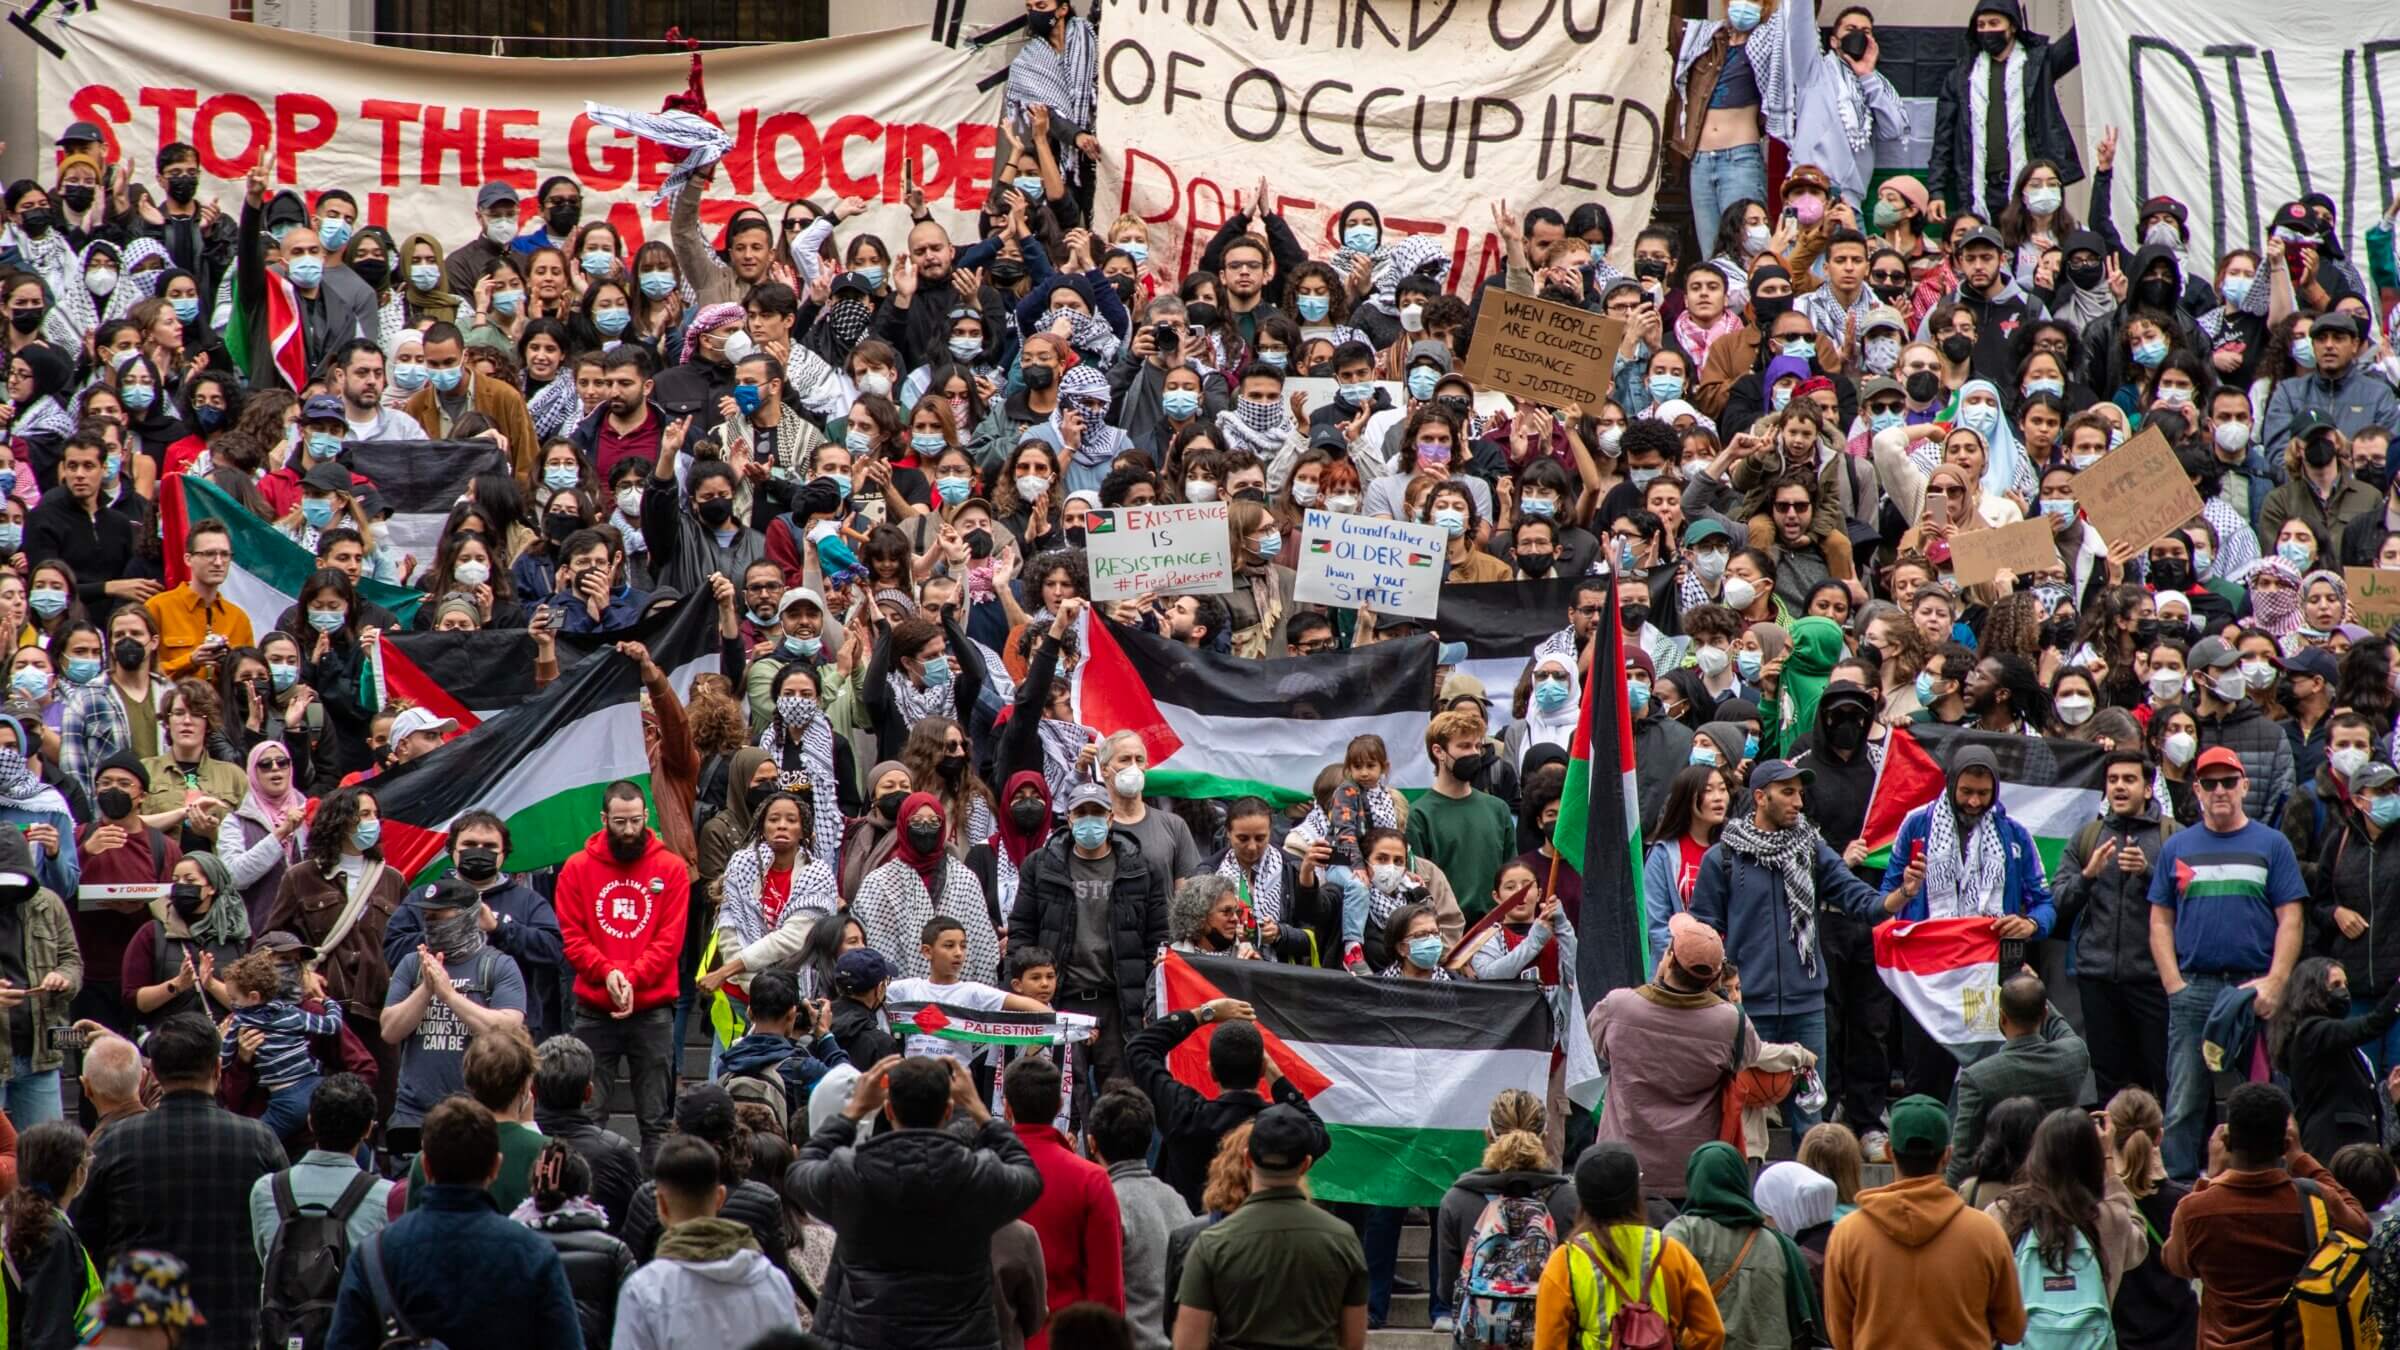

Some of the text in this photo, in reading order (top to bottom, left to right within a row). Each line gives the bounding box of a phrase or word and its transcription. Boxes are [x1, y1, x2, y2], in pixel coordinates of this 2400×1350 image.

[1103, 39, 1661, 197] OF OCCUPIED
[56, 84, 338, 184] STOP
[360, 99, 540, 188] THE
[1504, 301, 1600, 342] WHEN PEOPLE
[1501, 322, 1602, 361] ARE OCCUPIED
[1493, 343, 1576, 377] RESISTANCE
[1493, 367, 1596, 404] IS JUSTIFIED
[1126, 506, 1228, 530] EXISTENCE
[1308, 512, 1332, 530] MY
[1341, 518, 1424, 546] Grandfather
[1151, 530, 1173, 548] IS
[1335, 540, 1404, 568] OLDER
[1113, 570, 1224, 592] #FreePalestine
[1325, 564, 1407, 588] than your
[423, 1035, 464, 1051] CAN BE
[963, 1020, 1045, 1036] PALESTINE
